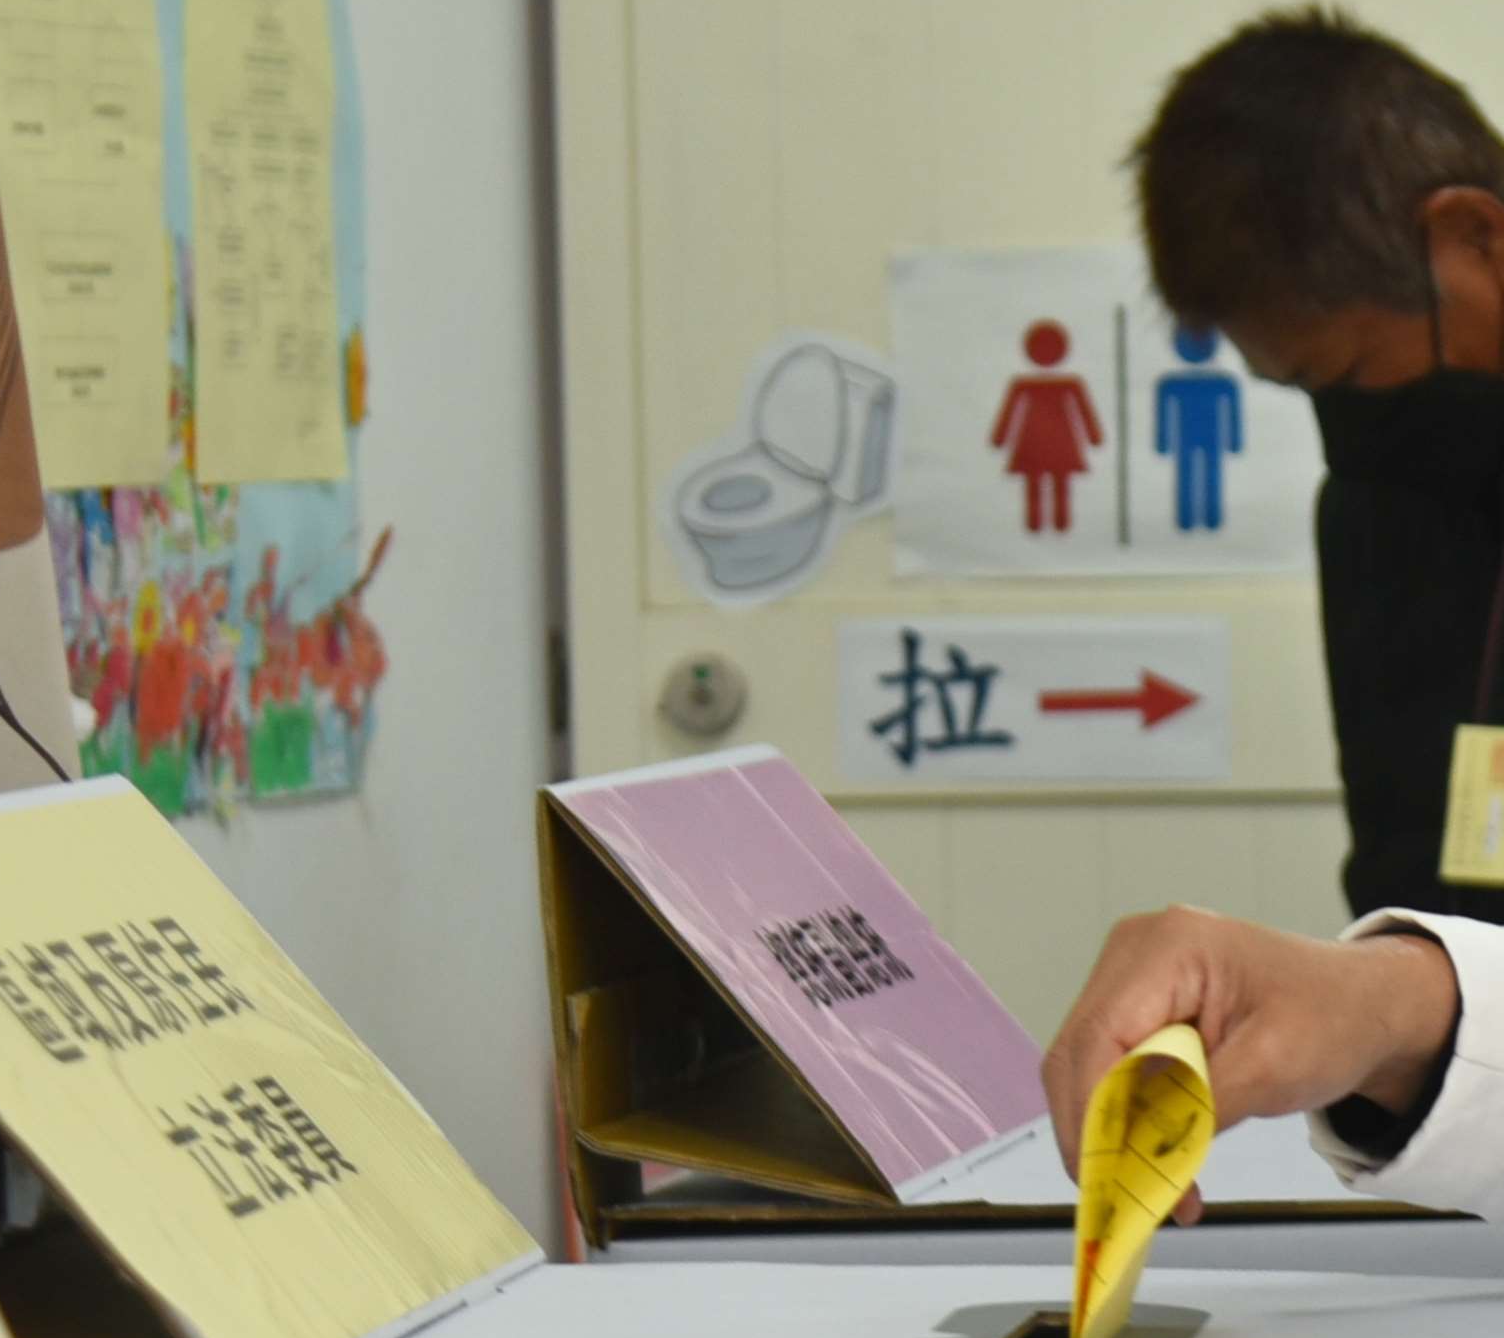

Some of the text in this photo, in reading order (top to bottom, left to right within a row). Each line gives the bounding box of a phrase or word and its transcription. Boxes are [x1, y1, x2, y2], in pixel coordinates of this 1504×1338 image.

[869, 628, 1014, 767] 拉
[165, 1073, 358, 1219] 立法委員
